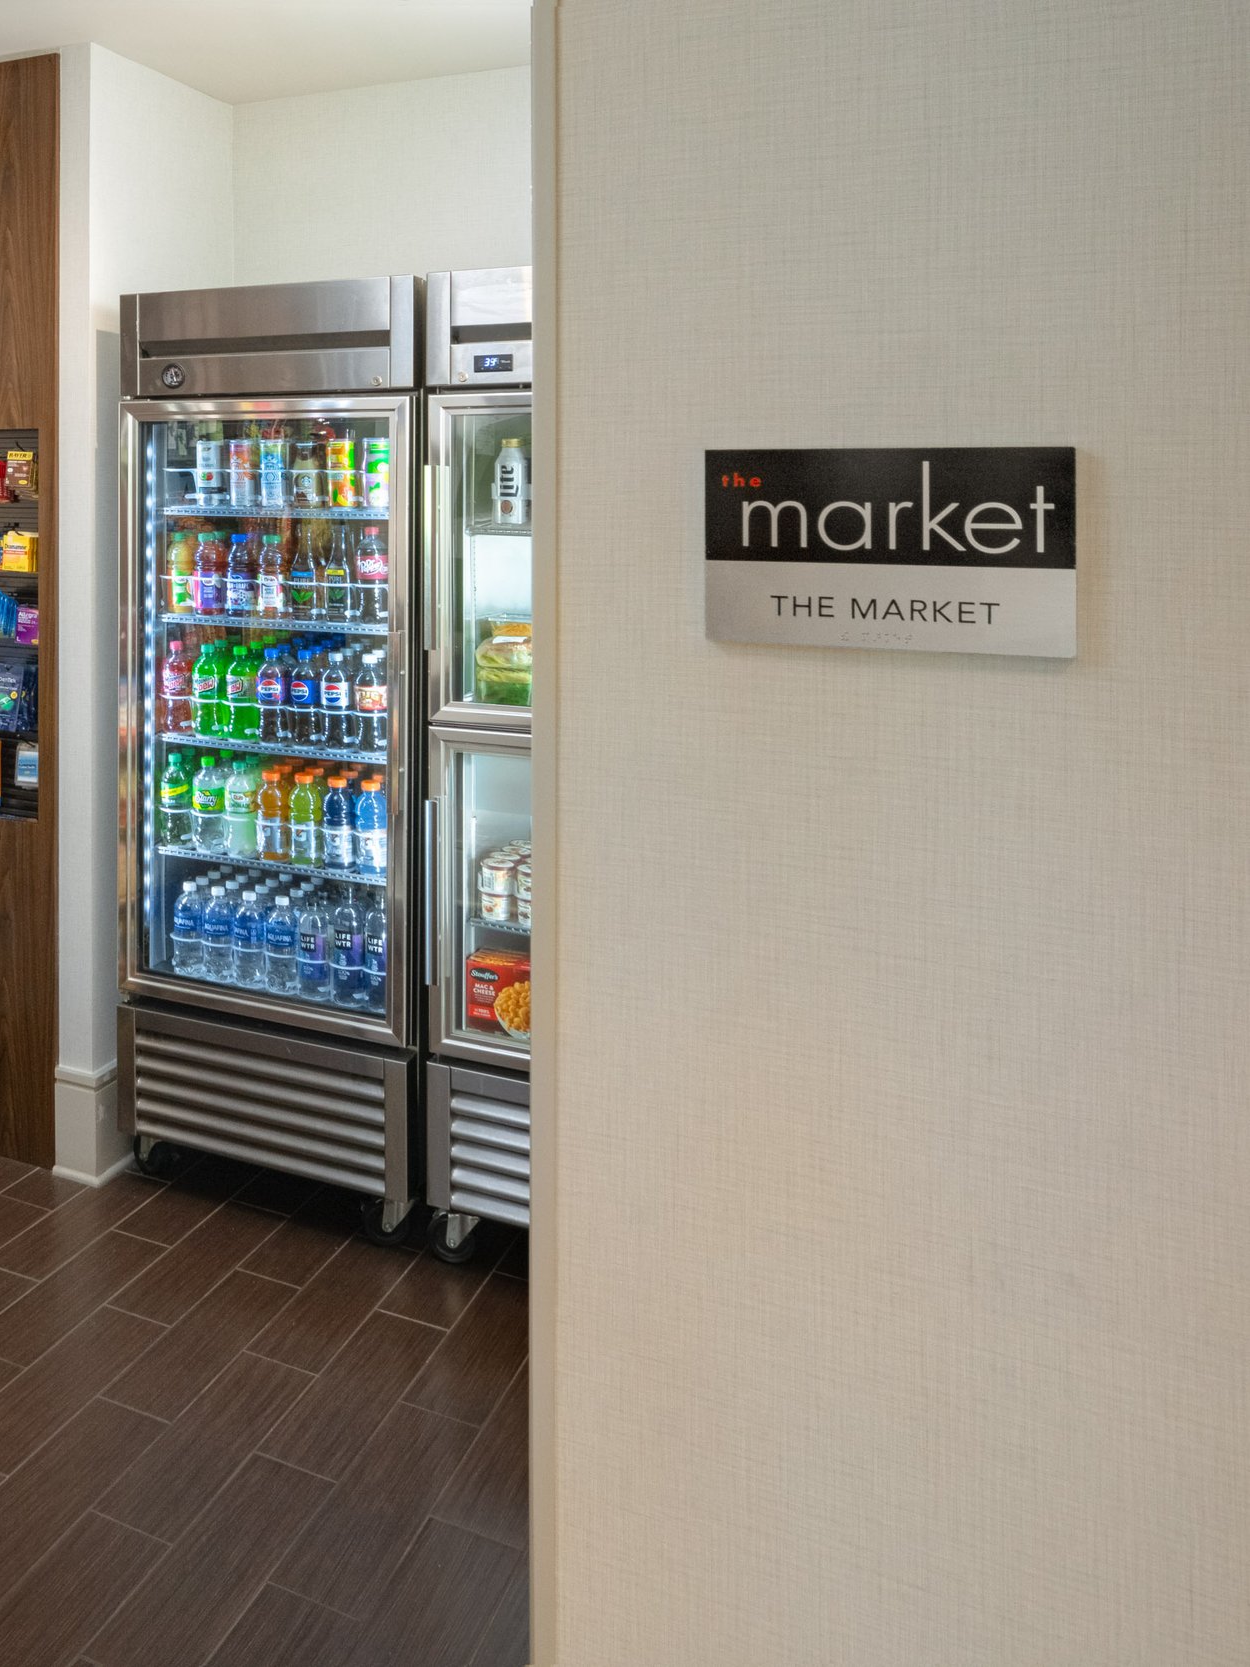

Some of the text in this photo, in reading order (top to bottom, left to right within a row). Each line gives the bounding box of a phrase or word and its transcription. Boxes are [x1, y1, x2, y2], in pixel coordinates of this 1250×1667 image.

[499, 464, 519, 498] Lite
[721, 472, 762, 489] the
[740, 460, 1056, 555] market
[770, 595, 1001, 626] THE MARKET
[300, 935, 315, 944] LIFE
[335, 931, 351, 941] LIFE
[335, 940, 352, 948] WTR
[367, 937, 383, 947] LIFE
[368, 945, 383, 954] WTR
[472, 988, 496, 997] CHEESE
